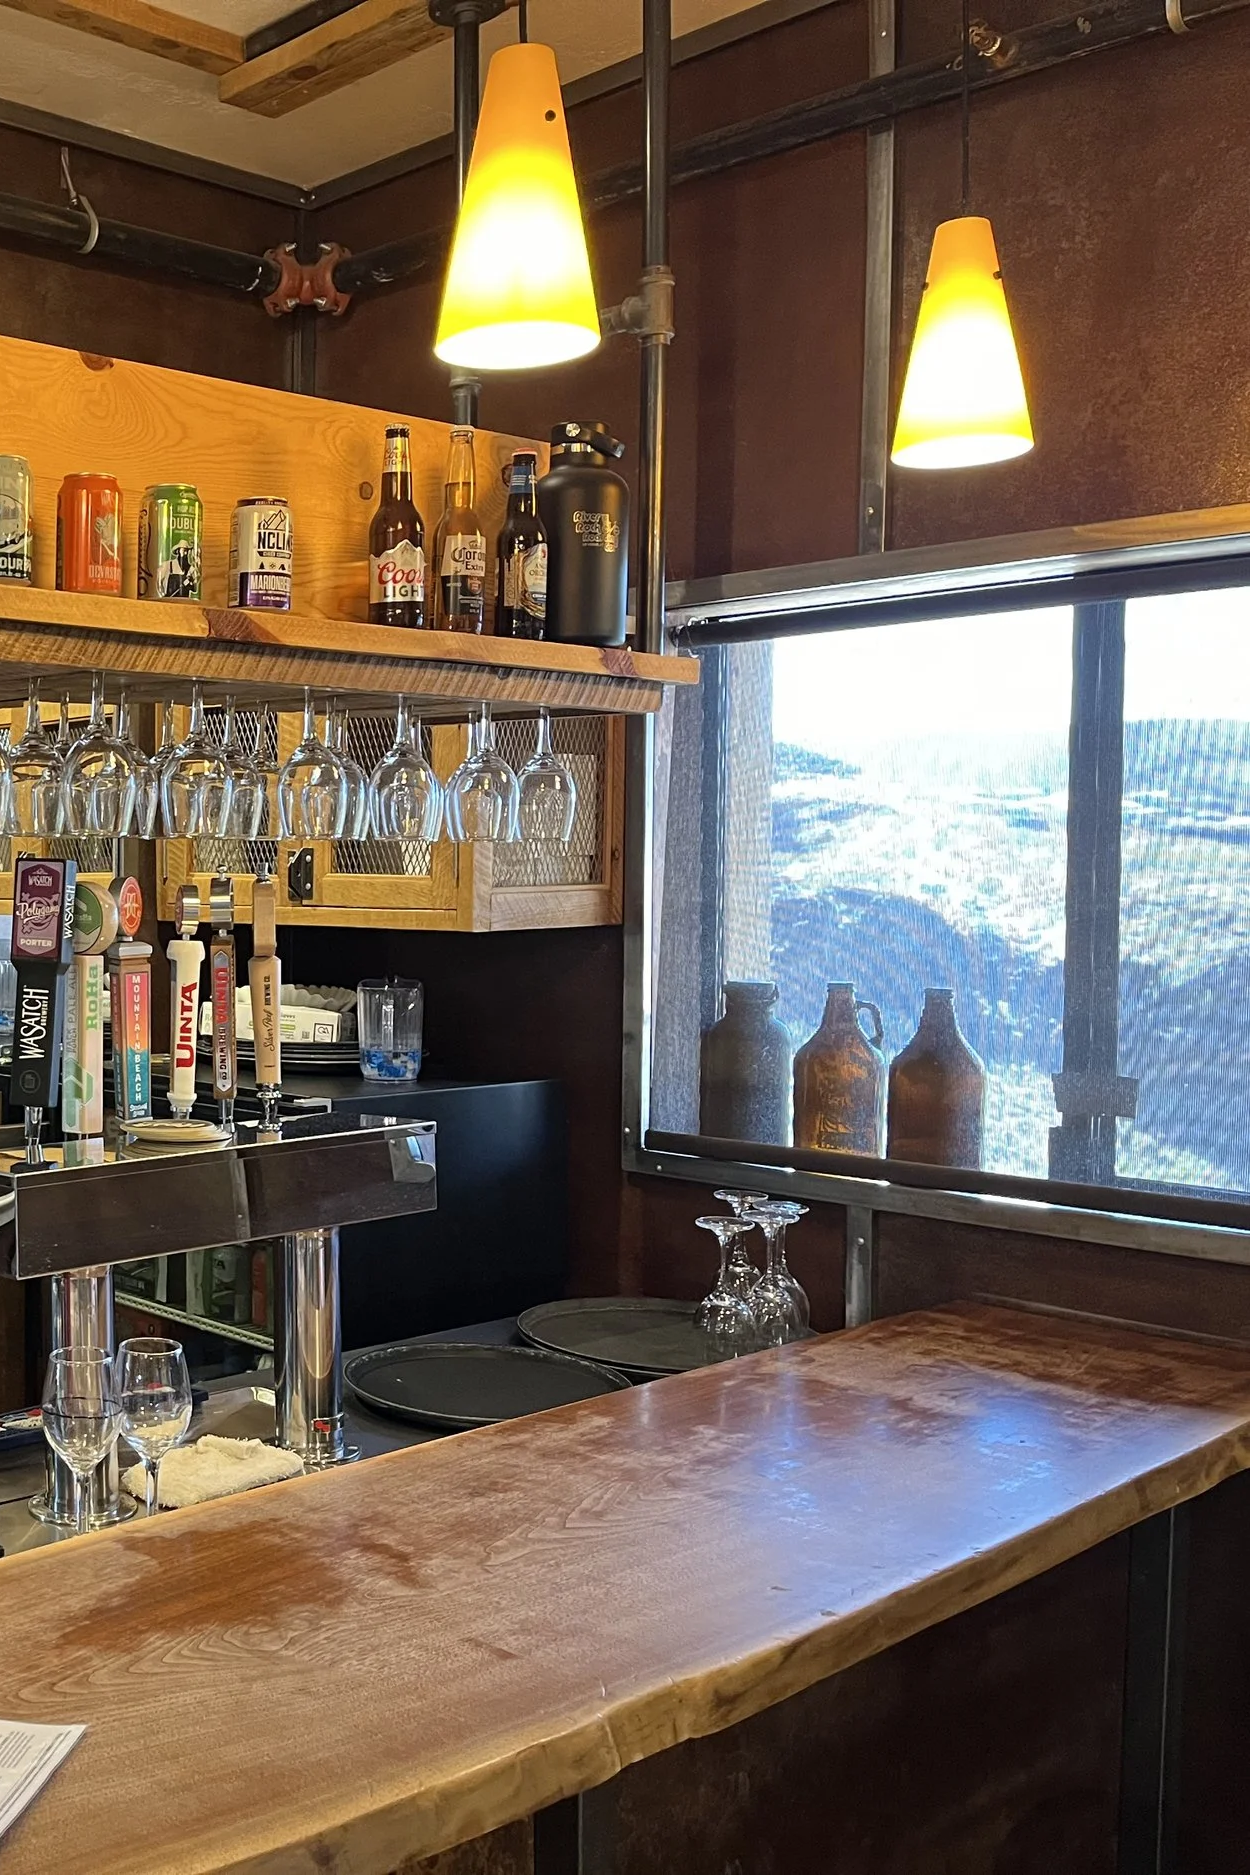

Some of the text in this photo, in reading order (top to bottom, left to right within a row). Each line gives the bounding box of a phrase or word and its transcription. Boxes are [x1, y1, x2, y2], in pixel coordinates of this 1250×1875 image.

[377, 561, 424, 585] Coor
[450, 547, 486, 564] Coron
[63, 885, 75, 939] WASATCH
[20, 938, 53, 948] PORTER
[40, 998, 49, 1027] BREWERY
[86, 963, 99, 1031] RoHa
[18, 987, 50, 1060] WASATCH
[132, 974, 142, 1101] MOUNTAIN BEACH
[175, 981, 198, 1069] UINTA
[219, 1027, 229, 1072] BREWING
